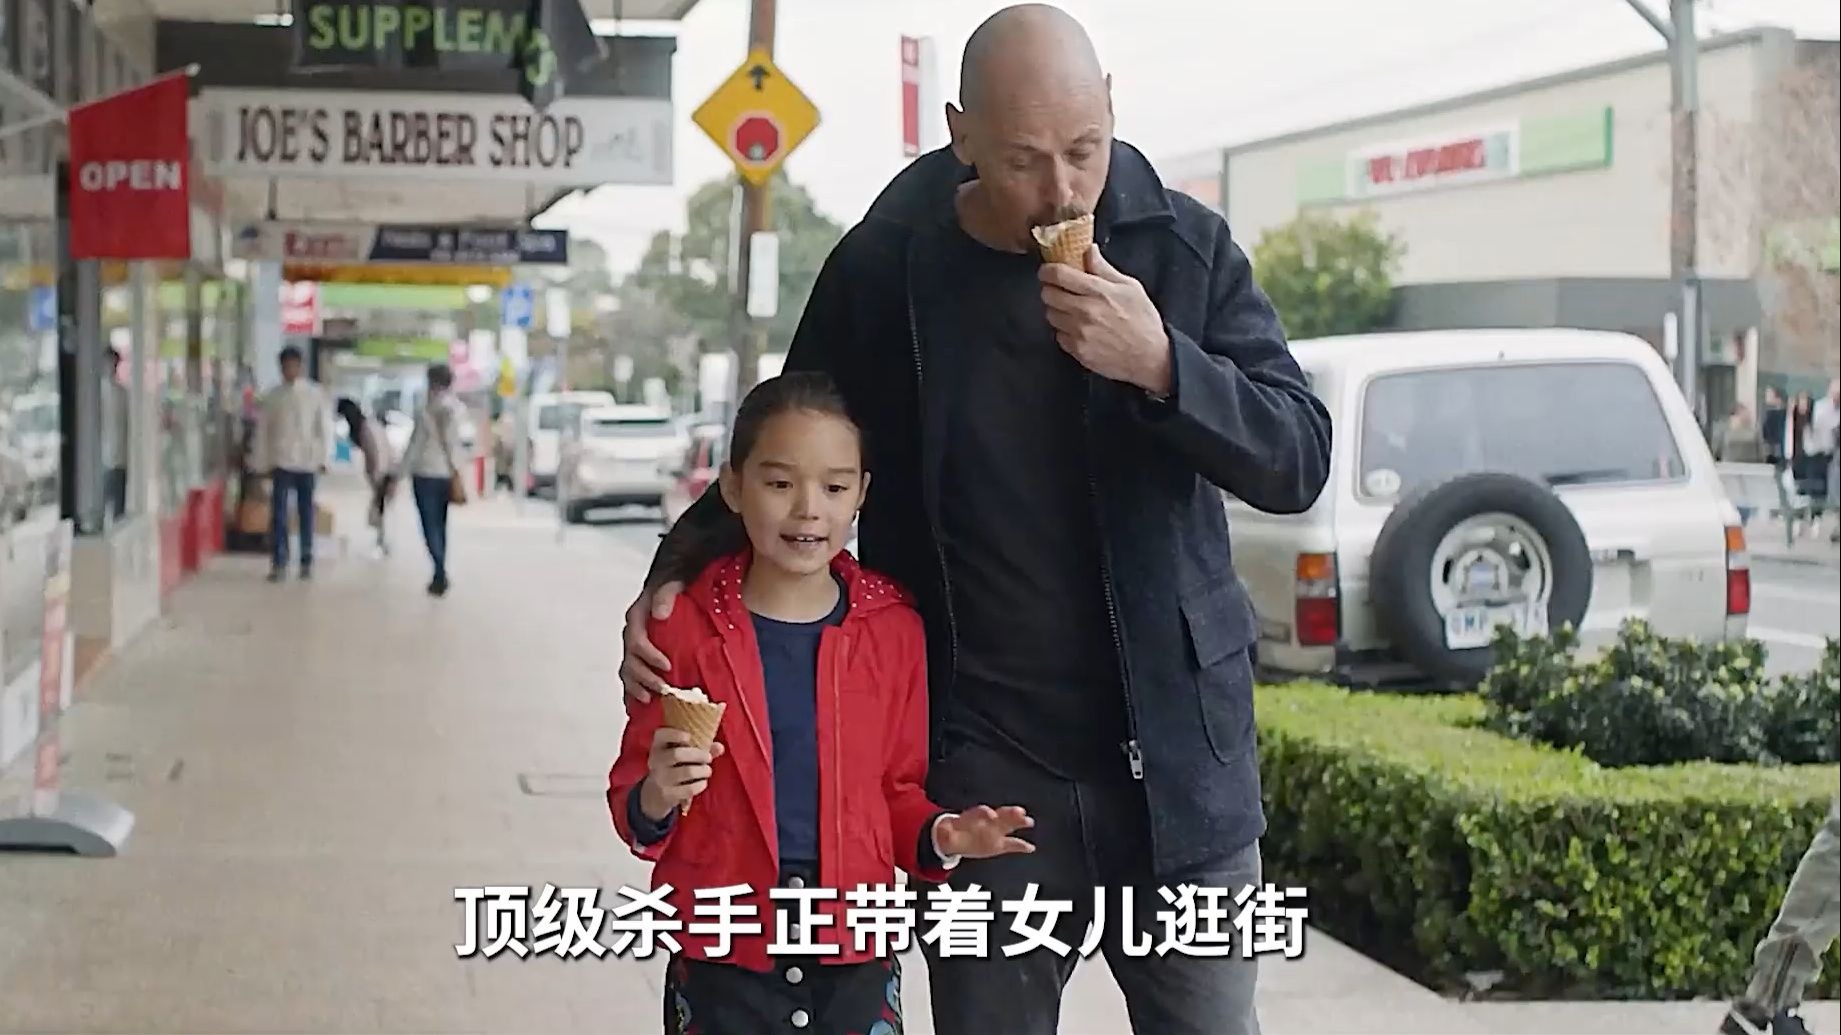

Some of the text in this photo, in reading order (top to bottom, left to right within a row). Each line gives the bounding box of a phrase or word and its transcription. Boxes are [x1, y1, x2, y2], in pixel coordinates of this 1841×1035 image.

[237, 105, 328, 162] JOE'S
[343, 109, 477, 166] BARBER
[490, 113, 584, 167] SHOP
[80, 160, 181, 192] OPEN
